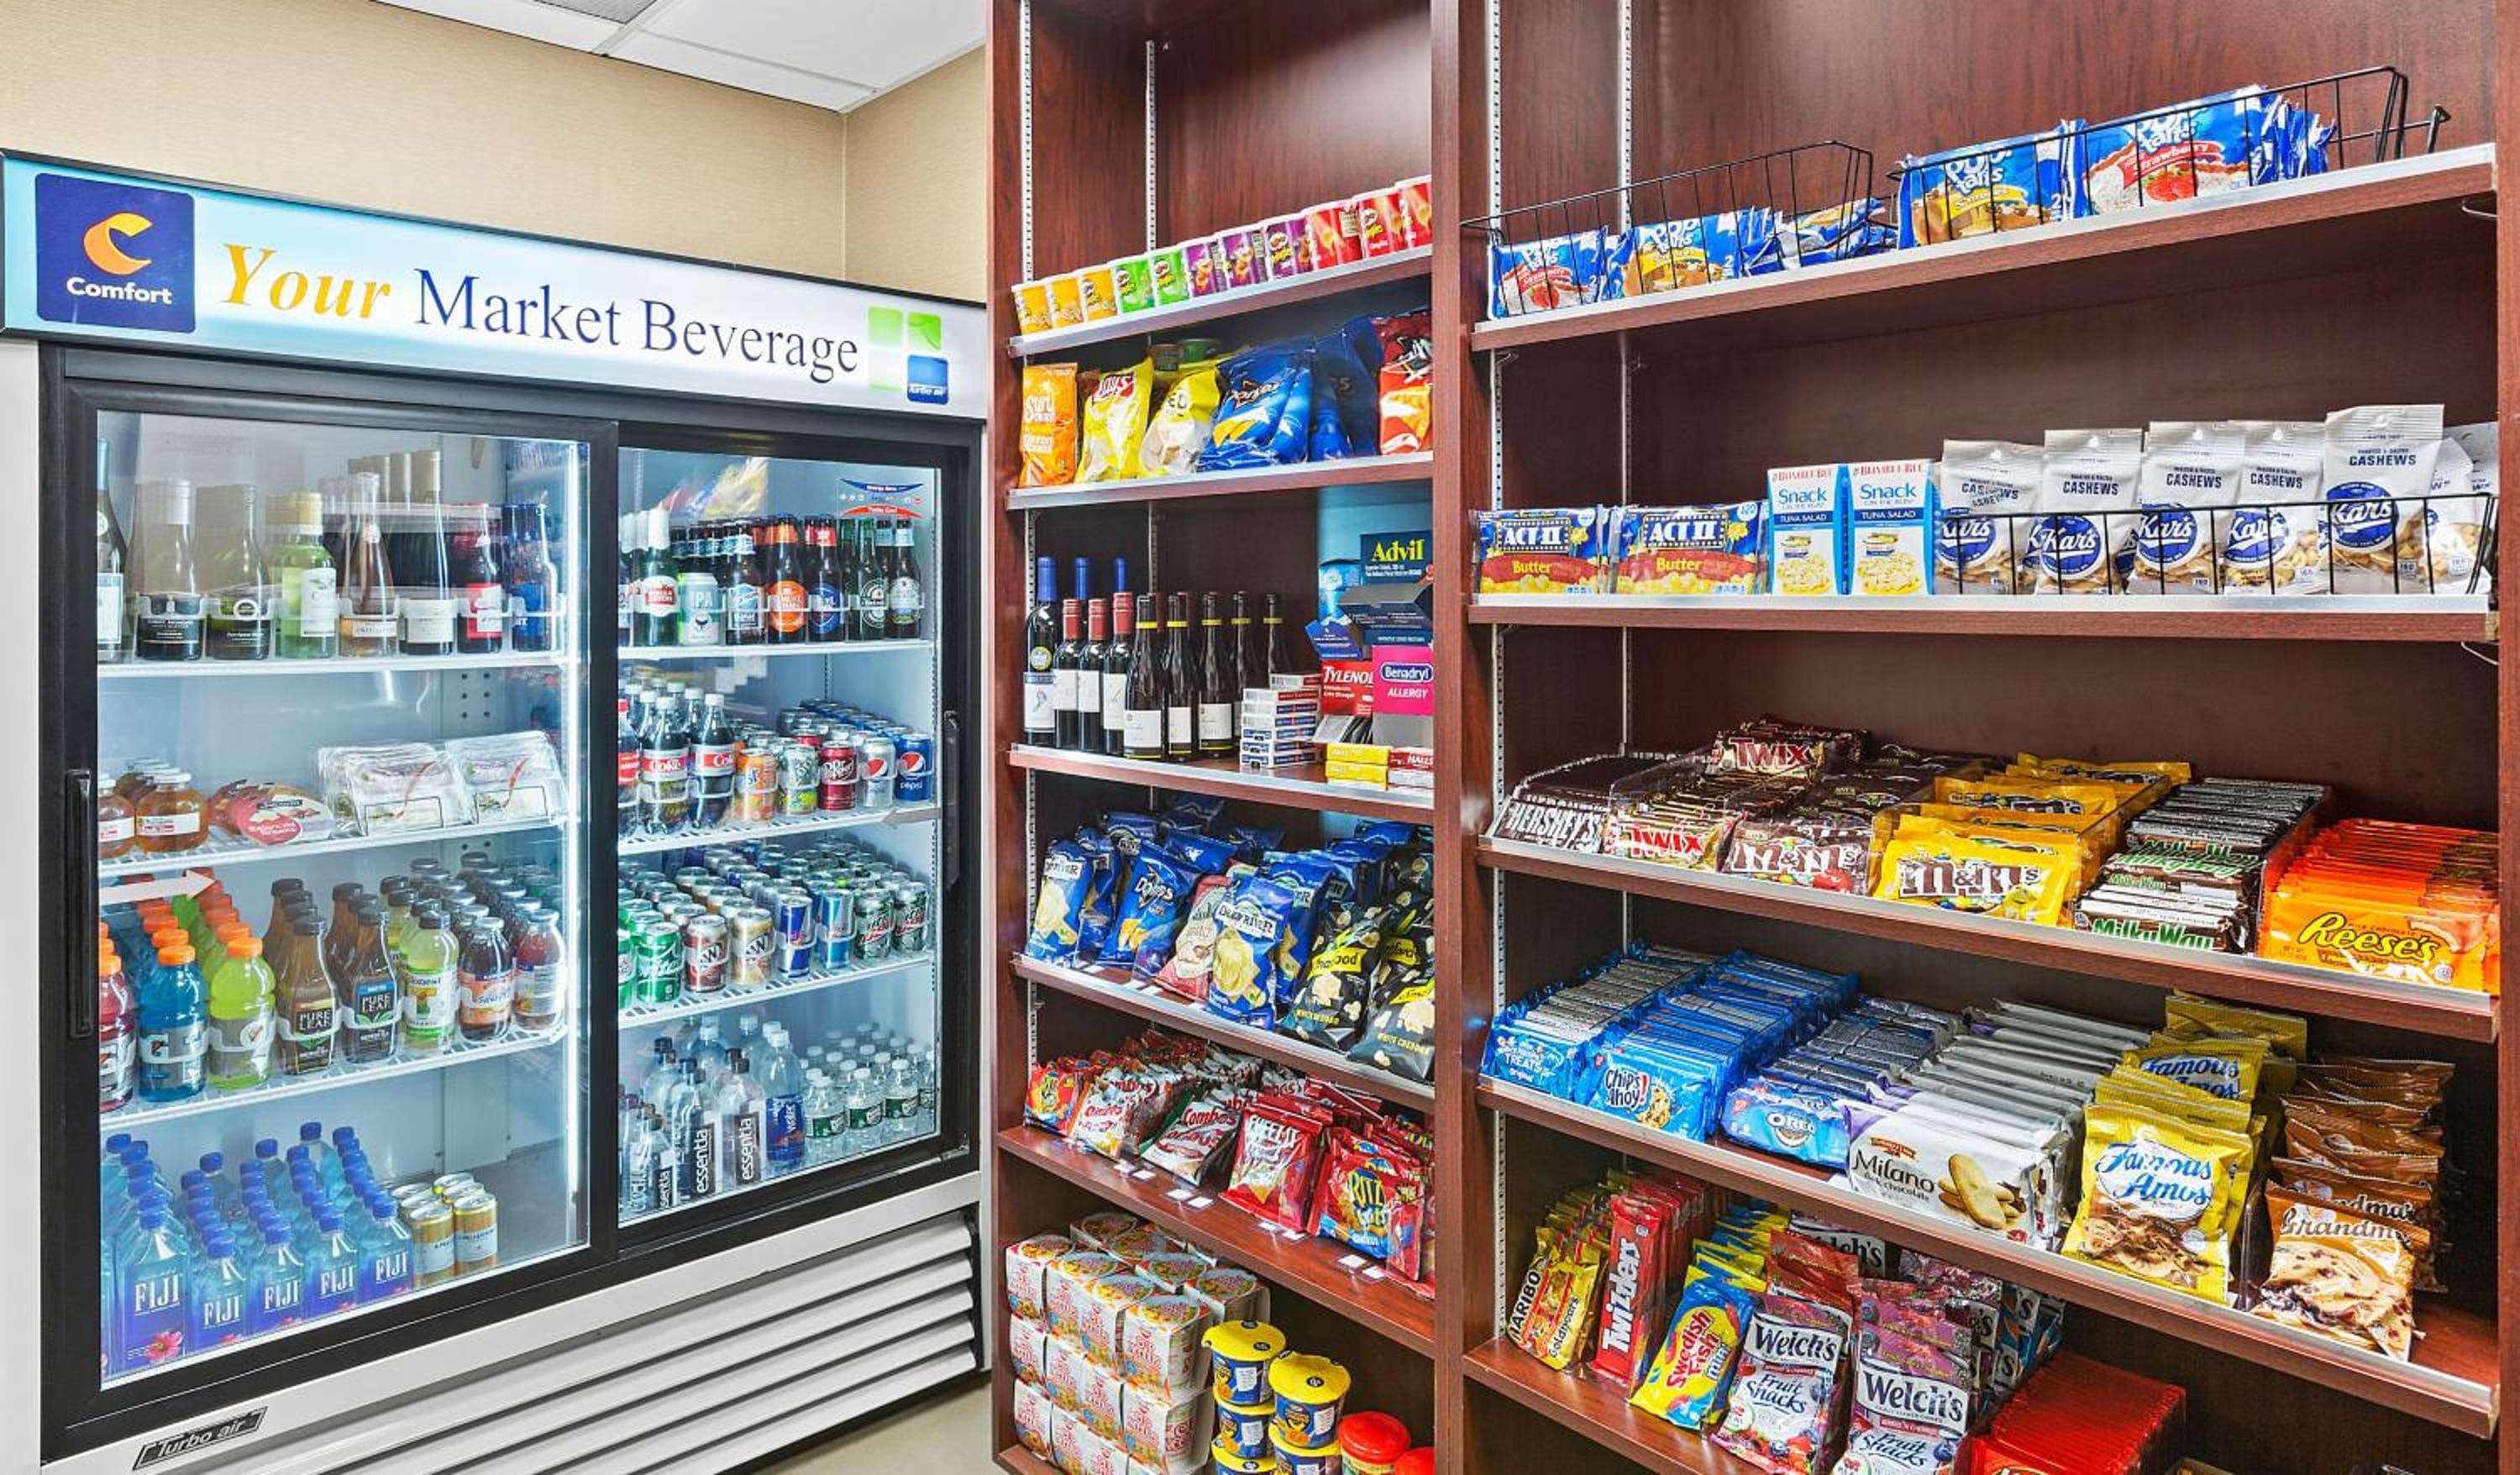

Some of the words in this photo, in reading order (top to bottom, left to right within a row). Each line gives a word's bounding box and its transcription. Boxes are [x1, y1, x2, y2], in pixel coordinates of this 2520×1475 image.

[66, 277, 173, 306] Comfort
[221, 244, 391, 319] Your
[414, 269, 620, 346] Market
[639, 297, 858, 384] Beverage
[2349, 454, 2417, 467] CASHEWS
[1778, 487, 1828, 504] Snack
[1860, 483, 1917, 501] Snack
[2062, 481, 2119, 496] CASHEWS
[2166, 473, 2222, 489] CASHEWS
[2250, 473, 2302, 490] CASHEWS
[1803, 514, 1827, 522] SALAD
[1861, 512, 1886, 520] TUNA
[1887, 511, 1916, 519] SALAD
[1504, 526, 1538, 546] ACT
[1649, 522, 1687, 543] ACT
[1690, 521, 1718, 540] II
[1371, 538, 1425, 562] Advil
[1512, 560, 1551, 575] Butter
[1656, 557, 1702, 573] Butter
[1322, 665, 1374, 684] TYLENOL
[1384, 666, 1430, 682] Benadryl
[1387, 687, 1428, 699] ALLERGY
[2297, 911, 2439, 963] Reese's
[1504, 1052, 1543, 1071] TREATS
[2139, 1056, 2239, 1078] Famous
[1605, 1069, 1641, 1090] Chips
[1183, 1108, 1237, 1126] Combos
[696, 1128, 709, 1194] essentia
[739, 1117, 753, 1180] essentia
[1853, 1148, 1935, 1194] Milano
[1348, 1172, 1385, 1207] RITZ
[2113, 1173, 2212, 1205] Amos
[320, 1265, 356, 1297] FIJI
[375, 1251, 408, 1284] FIJI
[134, 1274, 181, 1313] FIJI
[264, 1279, 301, 1310] FIJI
[1509, 1270, 1541, 1341] HARIBO
[203, 1296, 243, 1327] FIJI
[1548, 1296, 1579, 1358] Goldbears
[1755, 1320, 1837, 1362] Welch's
[1667, 1310, 1714, 1388] Swedish
[1688, 1333, 1721, 1378] Fish
[1706, 1344, 1730, 1381] mini
[1746, 1380, 1808, 1414] Snacks
[1761, 1373, 1803, 1395] Fruit
[1864, 1371, 1963, 1424] Welch's
[158, 1431, 213, 1457] Turbo
[218, 1419, 246, 1437] air
[1859, 1436, 1928, 1467] Snacks
[1880, 1432, 1927, 1453] Fruit
